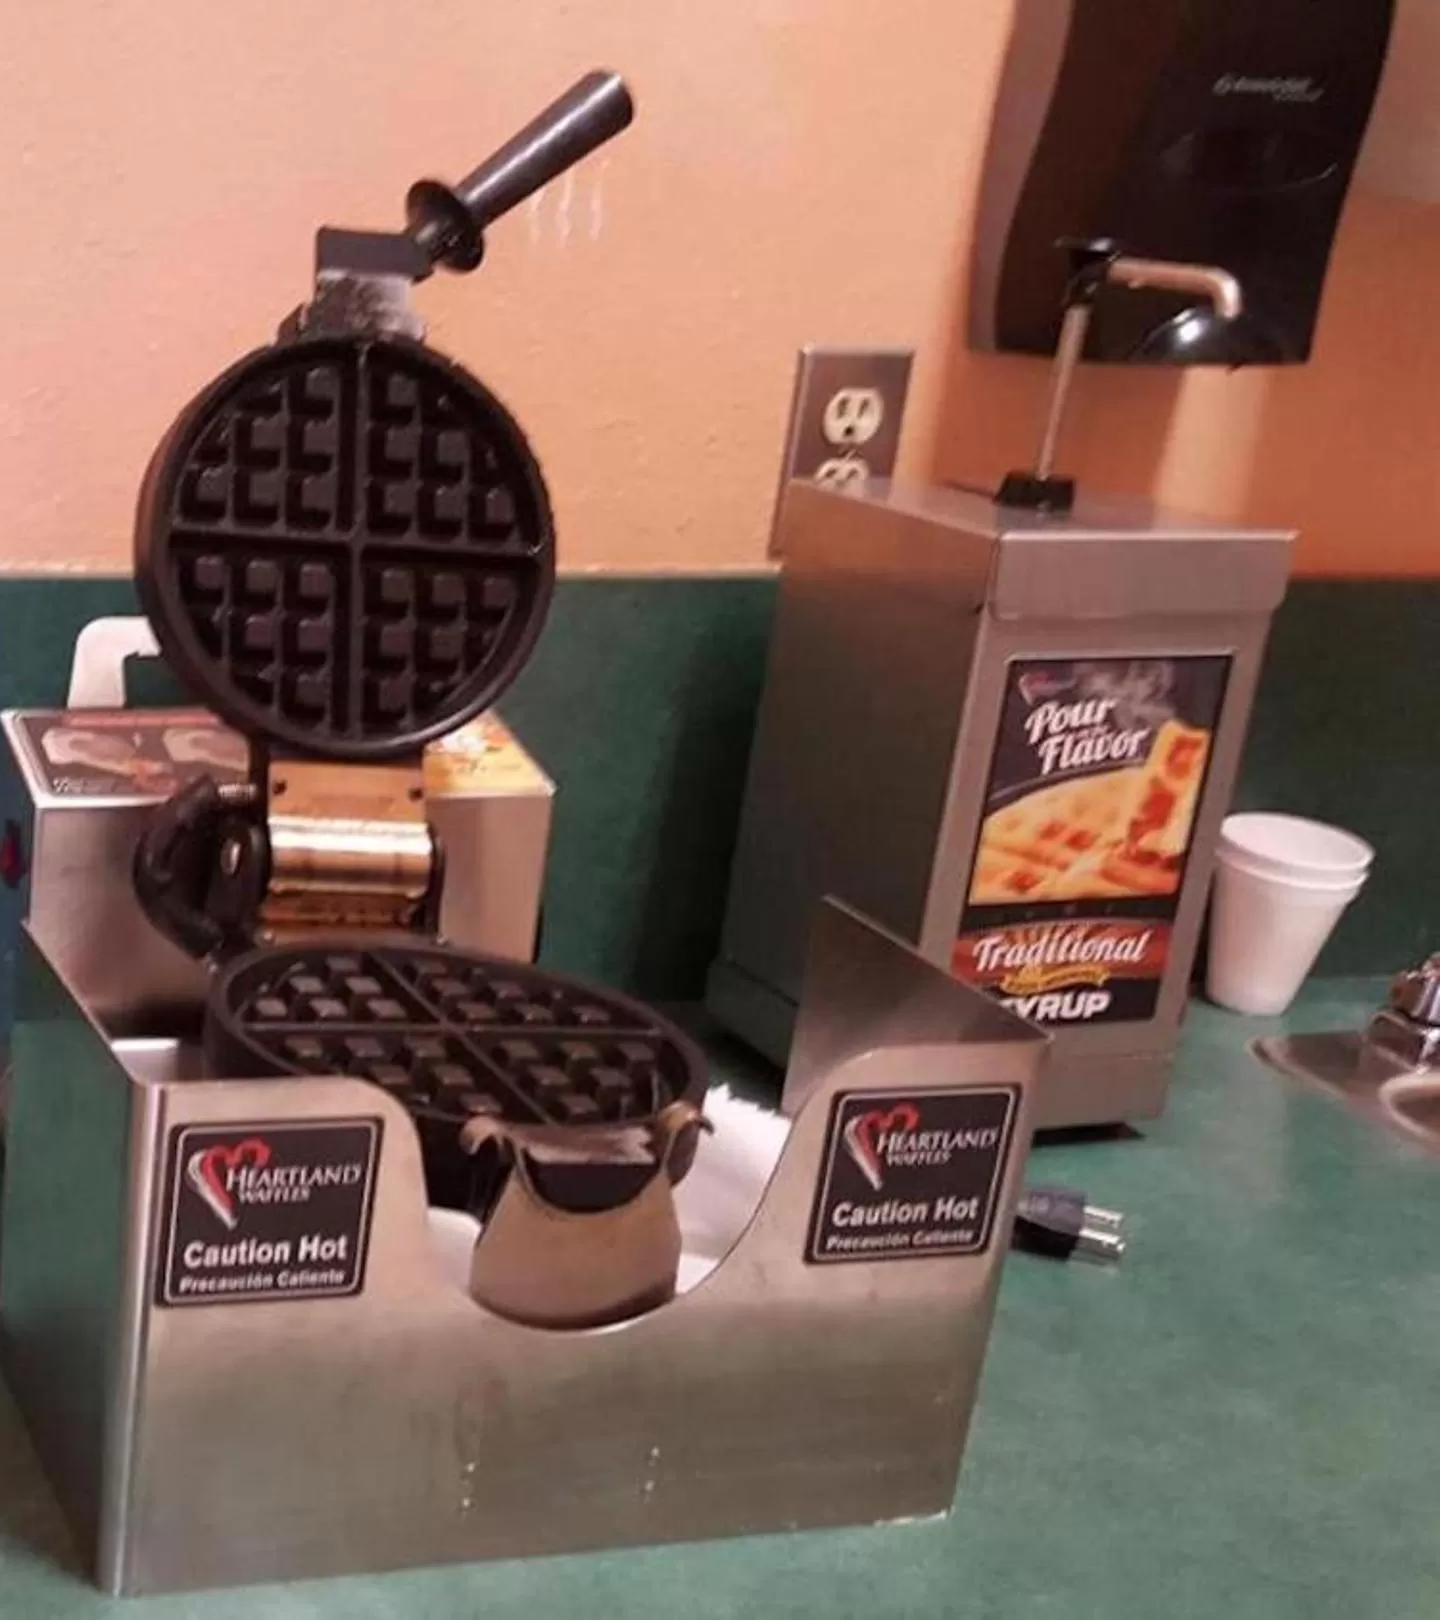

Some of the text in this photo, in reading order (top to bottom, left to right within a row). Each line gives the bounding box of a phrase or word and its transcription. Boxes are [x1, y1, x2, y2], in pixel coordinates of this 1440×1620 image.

[1024, 699, 1119, 745] Pour
[1038, 727, 1152, 775] Flavor
[973, 930, 1152, 971] Traditional
[1000, 993, 1110, 1020] YRUP
[876, 1128, 998, 1154] HEARTLAND
[225, 1163, 361, 1191] HEARTLAND
[237, 1185, 311, 1204] WAFFLES
[831, 1196, 980, 1227] Caution Hot
[183, 1233, 348, 1269] Caution Hot
[912, 1228, 975, 1246] Caliente
[276, 1268, 345, 1288] Caliente
